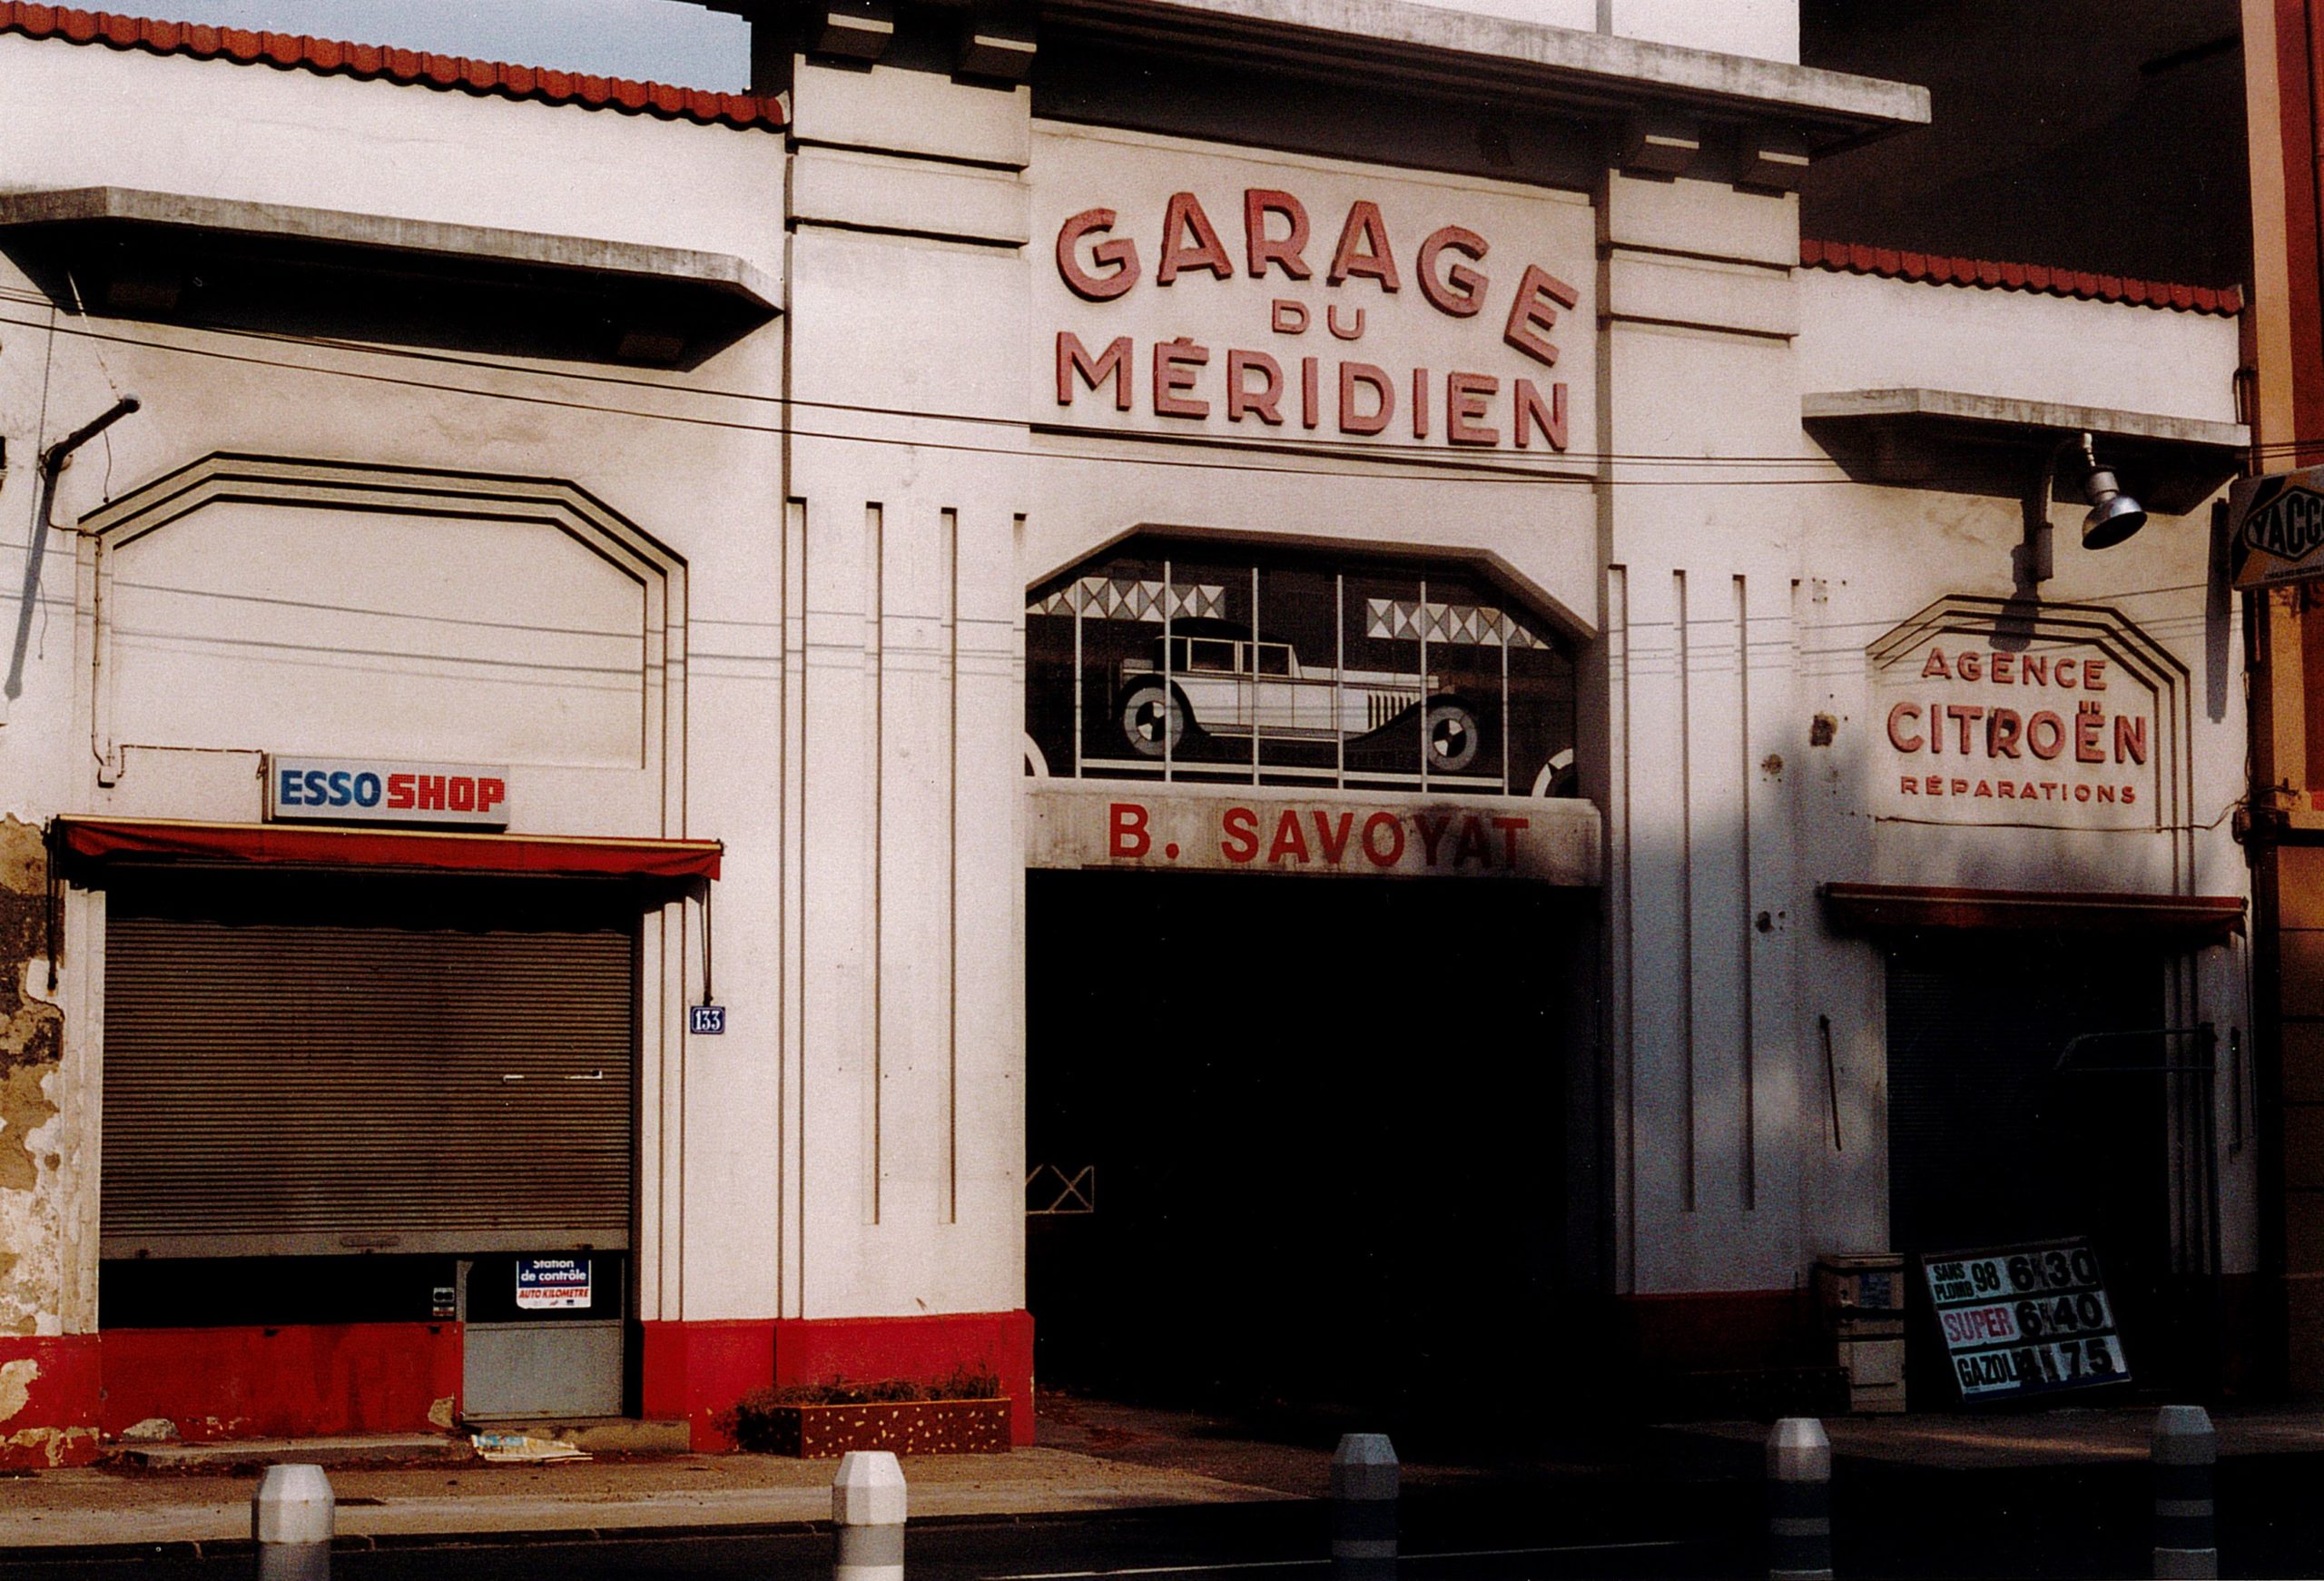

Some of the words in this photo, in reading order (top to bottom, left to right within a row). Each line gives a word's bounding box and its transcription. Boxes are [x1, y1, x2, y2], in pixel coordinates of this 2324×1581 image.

[1056, 188, 1581, 367] GARAGE
[1271, 300, 1365, 340] DU
[1056, 331, 1569, 450] MÉRIDIEN
[2252, 494, 2324, 554] YACC
[1921, 647, 2107, 690] AGENCE
[1887, 700, 2146, 765] CITROËN
[281, 770, 381, 807] ESSO
[387, 774, 505, 812] SHOP
[1900, 776, 2136, 805] RÉPARATIONS
[1109, 803, 1180, 860] B.
[1220, 806, 1530, 869] SAVOYAT
[695, 1010, 721, 1031] 133
[521, 1270, 536, 1281] de
[538, 1269, 586, 1281] contrôle
[1934, 1263, 1965, 1281] SANS
[1934, 1281, 1974, 1300] PLOMB
[1972, 1261, 2001, 1292] 98
[519, 1289, 541, 1299] AUTO
[1944, 1307, 2014, 1342] SUPER
